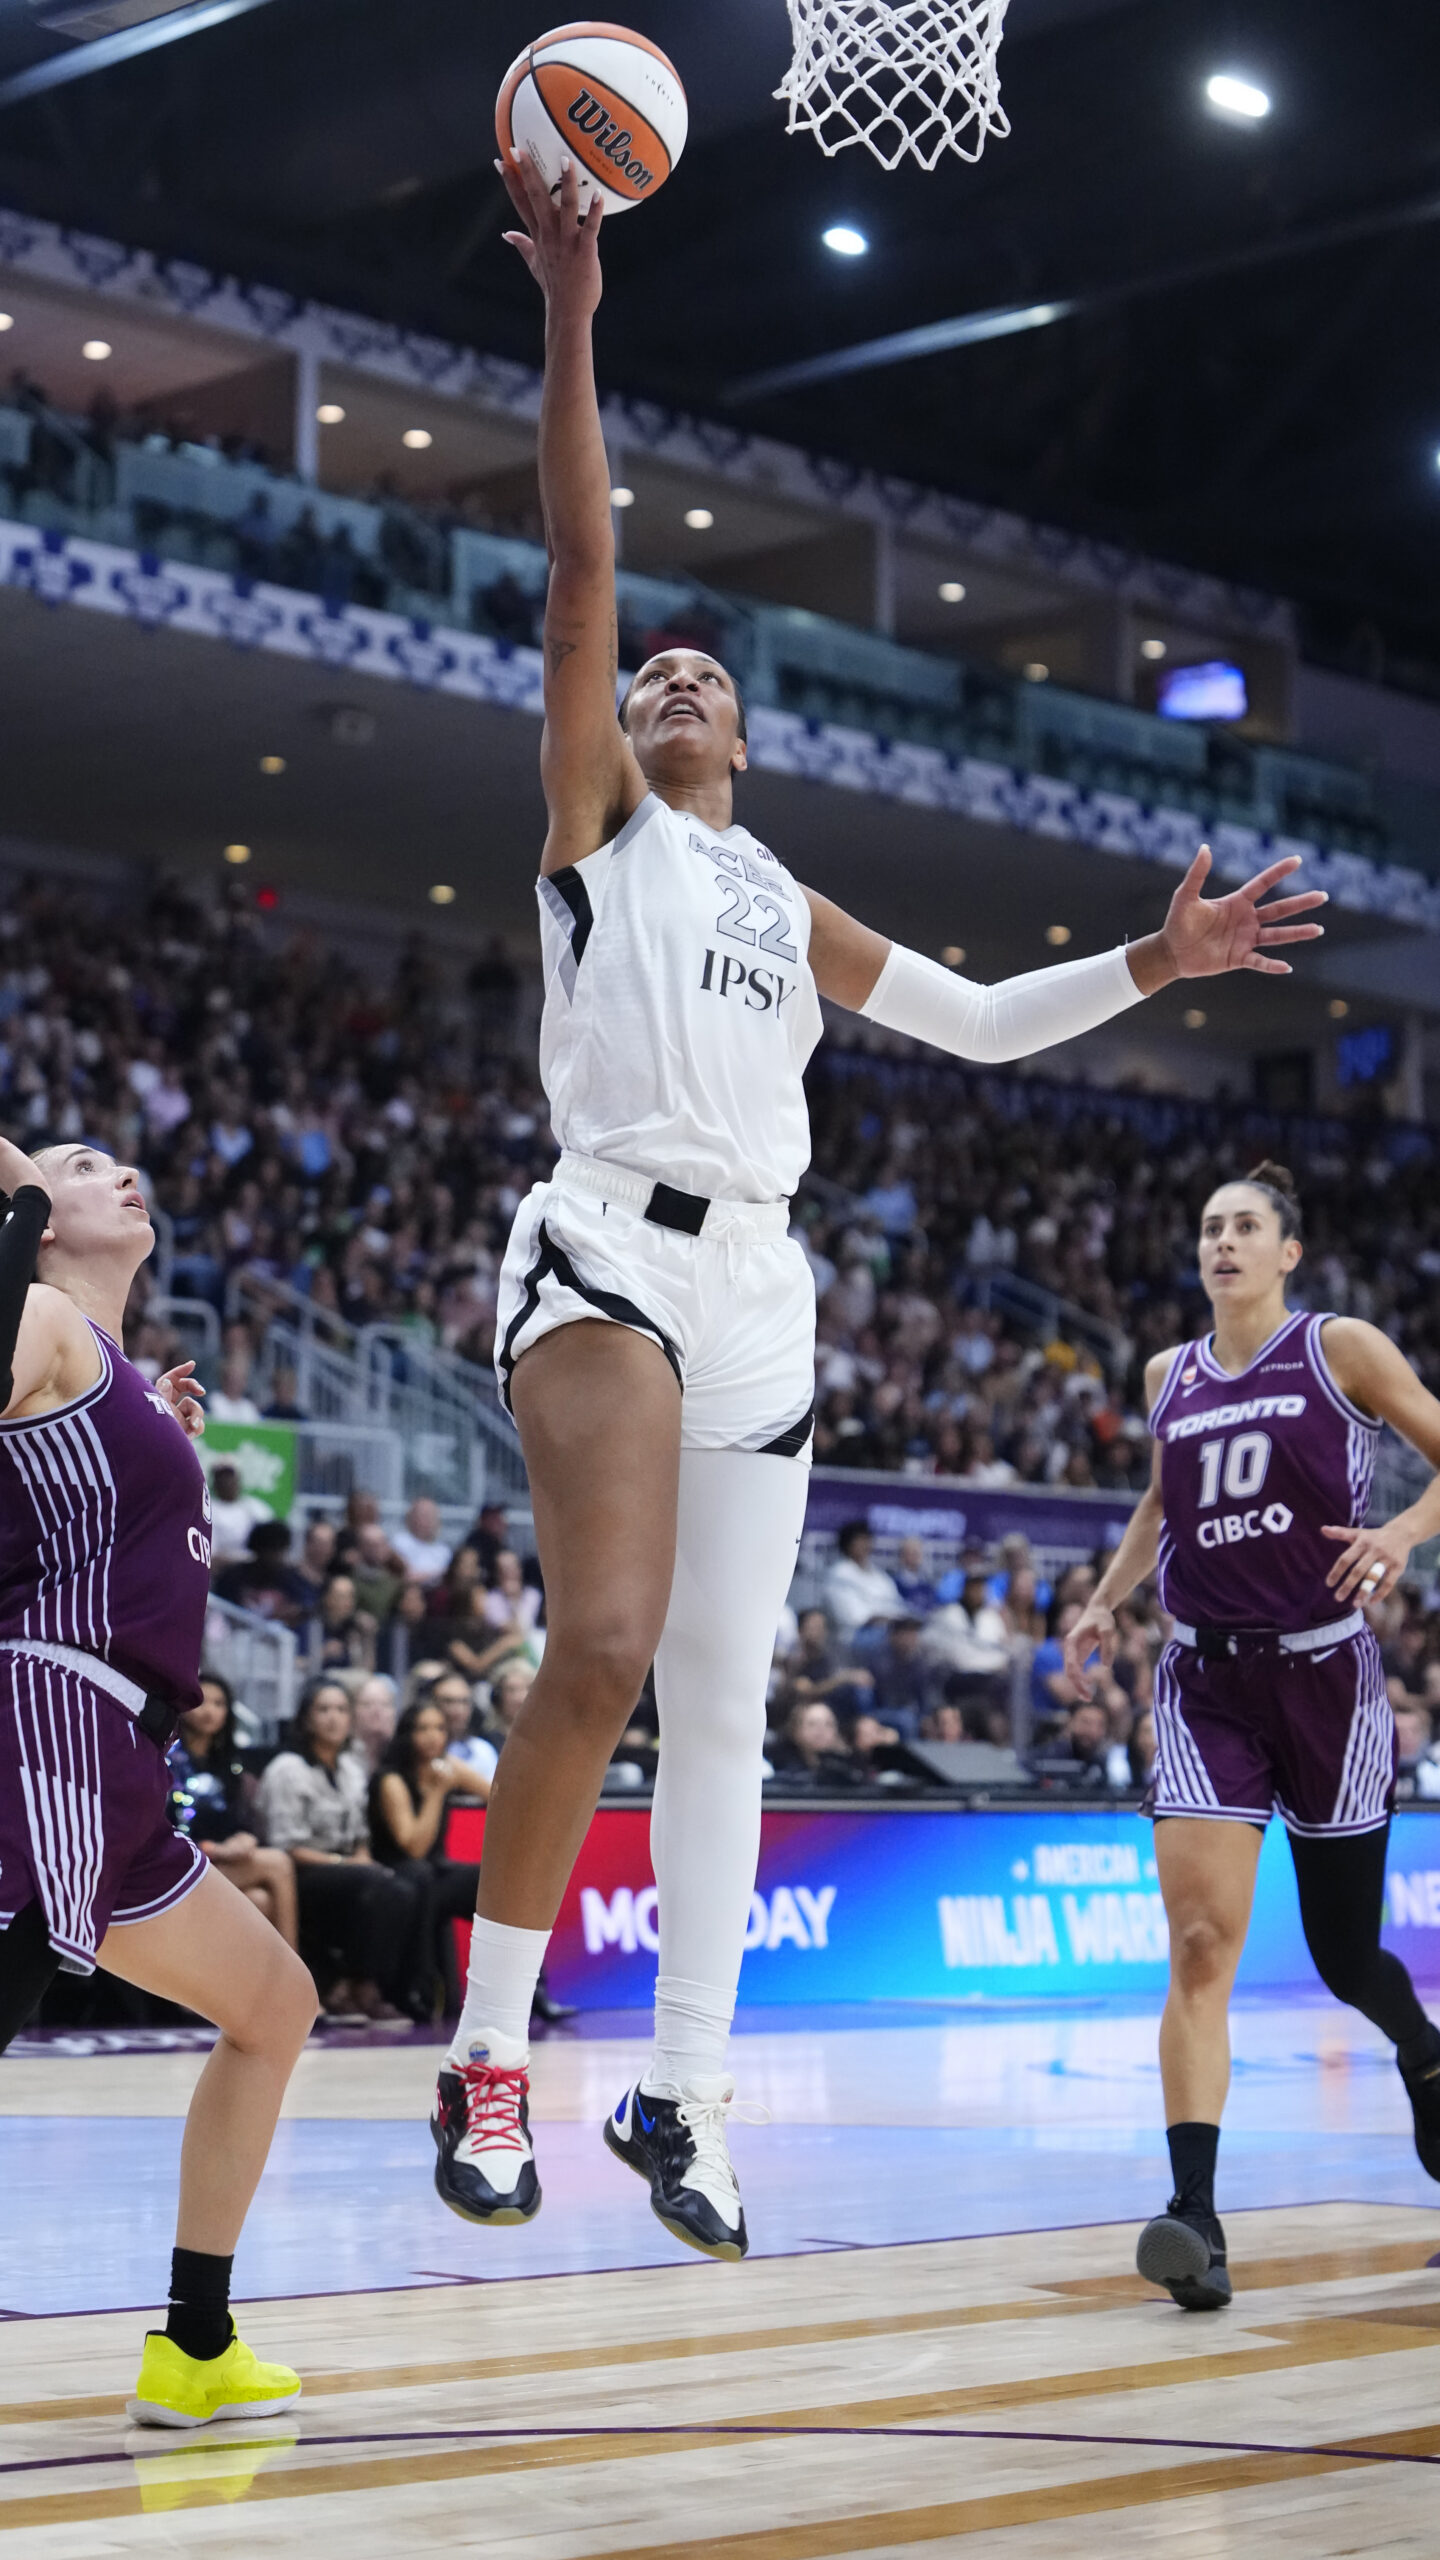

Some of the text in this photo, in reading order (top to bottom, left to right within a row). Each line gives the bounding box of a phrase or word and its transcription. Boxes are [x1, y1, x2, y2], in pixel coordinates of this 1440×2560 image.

[567, 87, 655, 191] Wilson
[715, 875, 797, 964] 22
[700, 949, 797, 1019] IPSY
[1166, 1394, 1307, 1444] TORONTO
[1198, 1431, 1272, 1509] 10
[1196, 1510, 1263, 1549] CIBC
[580, 1886, 838, 1955] MODAY
[938, 1895, 1060, 1968] NINJA
